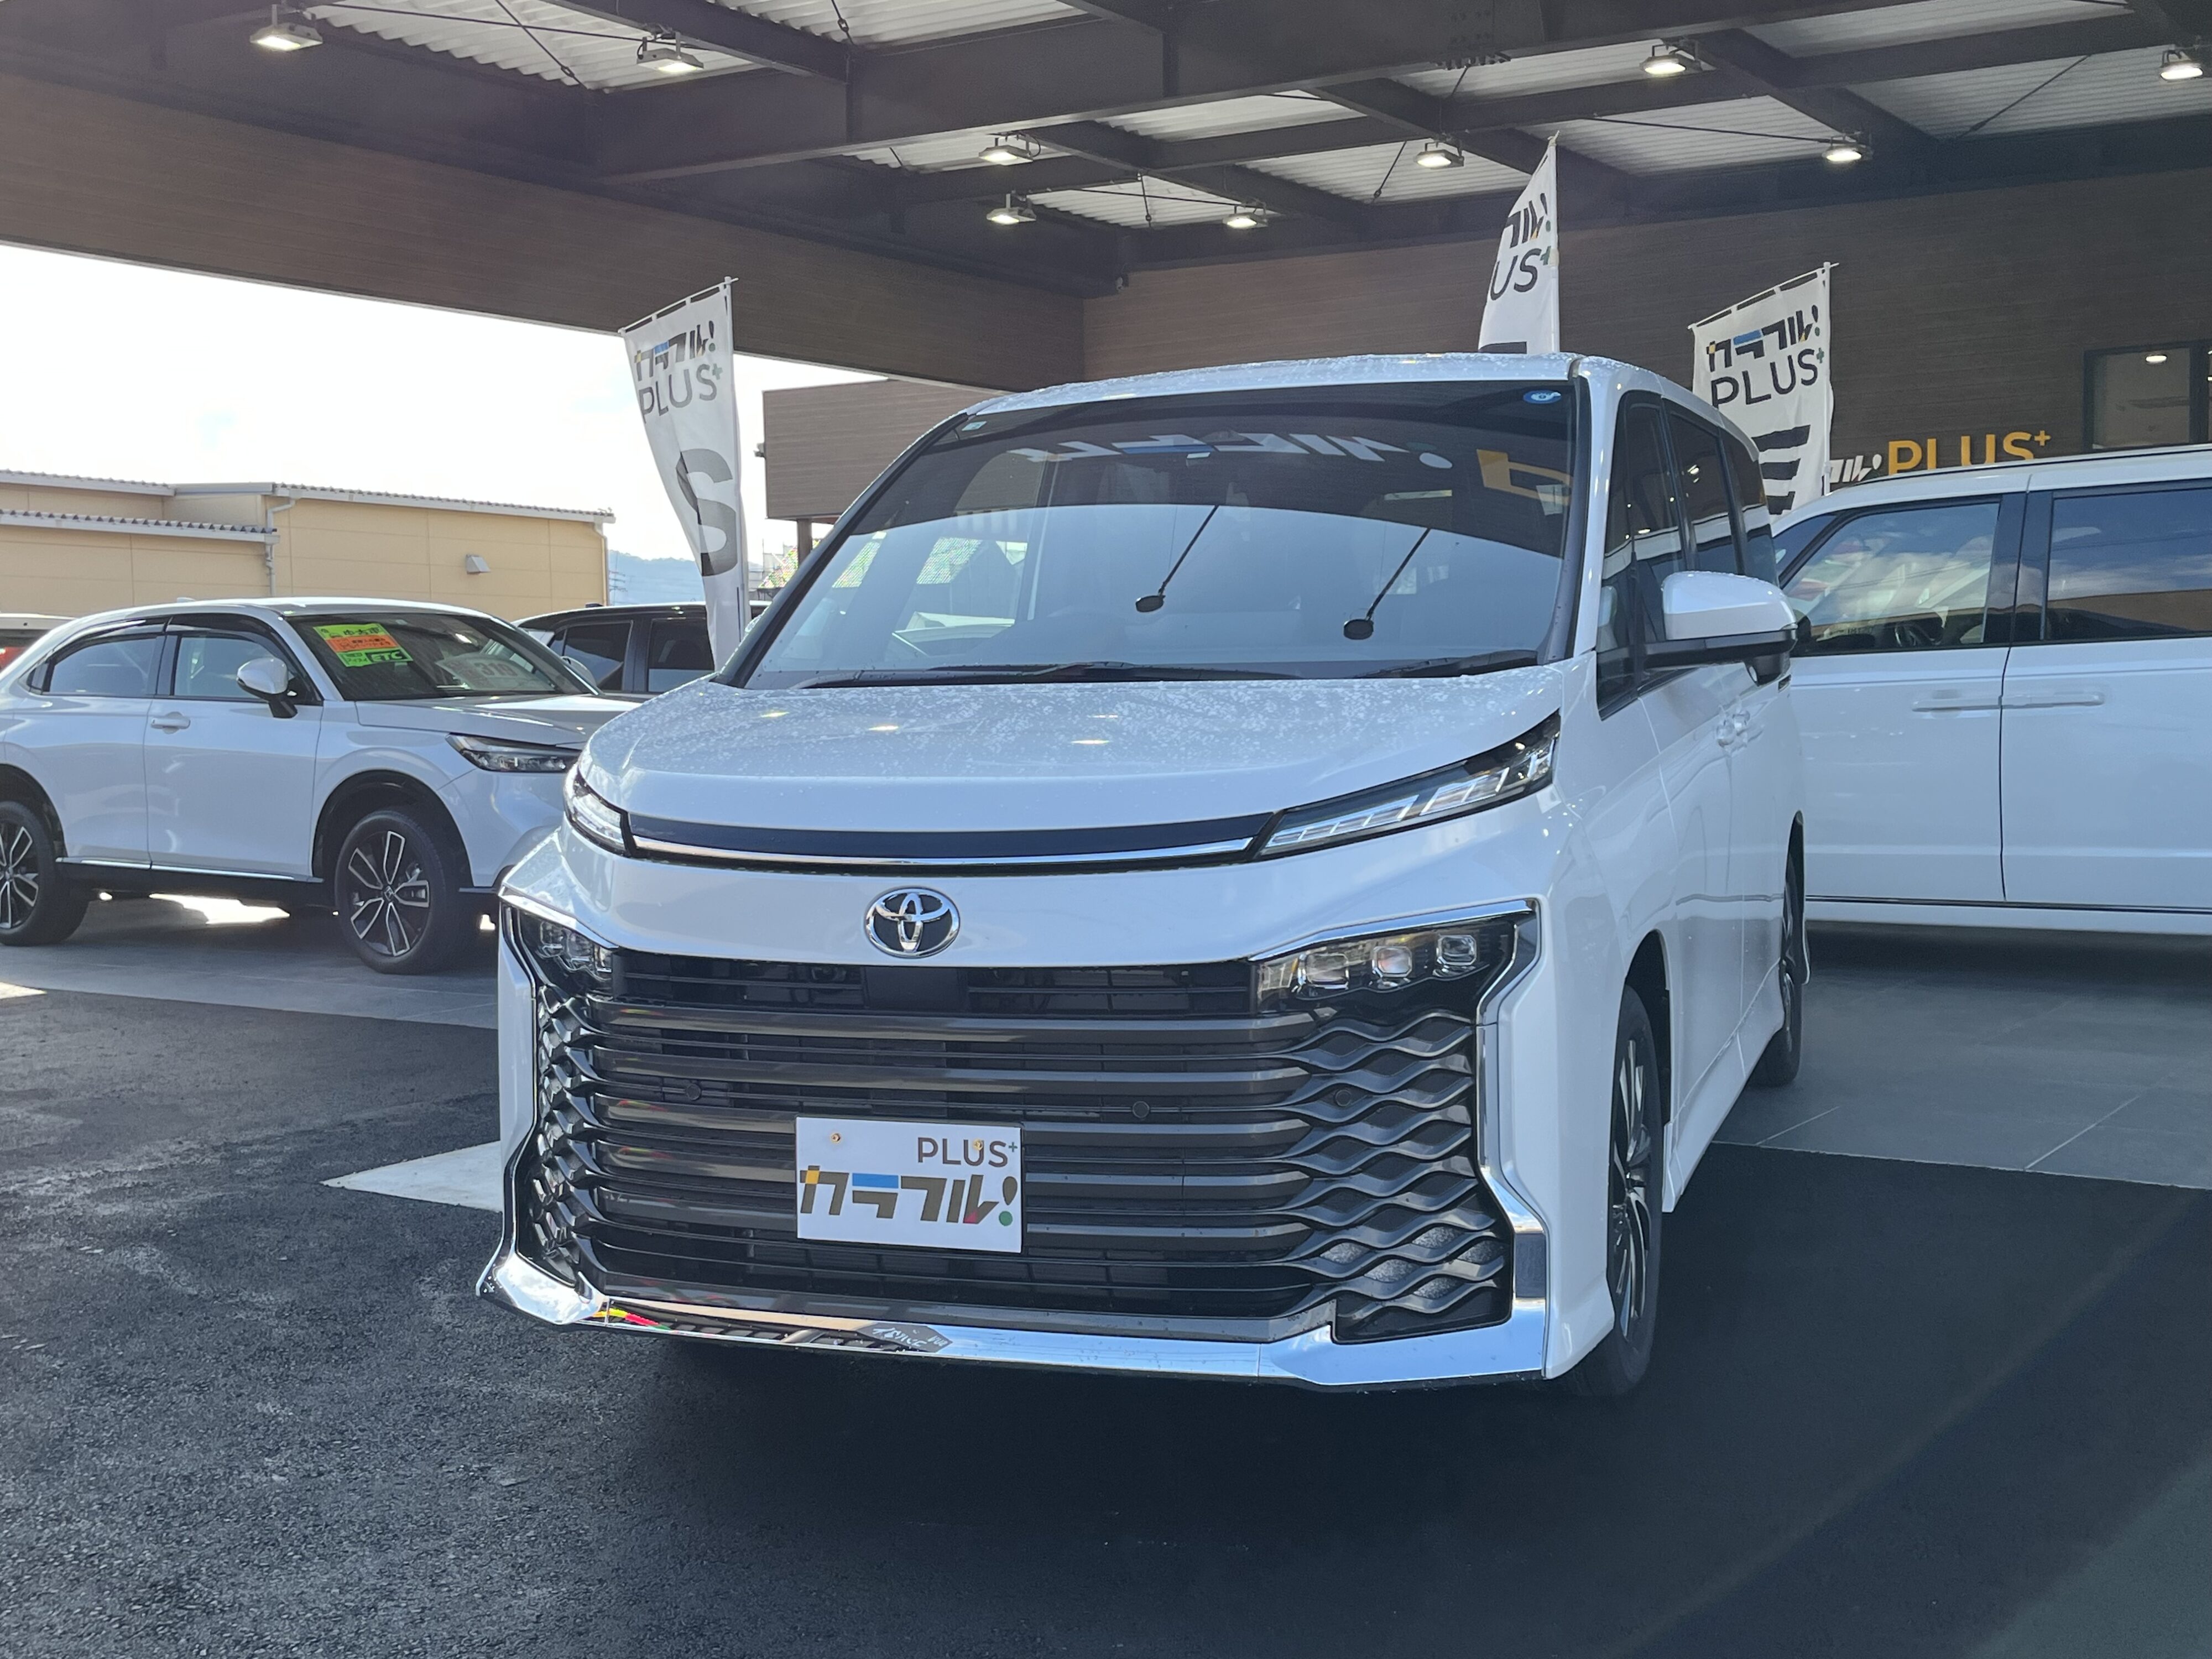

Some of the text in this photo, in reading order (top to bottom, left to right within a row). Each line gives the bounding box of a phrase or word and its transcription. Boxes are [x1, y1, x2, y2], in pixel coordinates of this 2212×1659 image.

[1706, 305, 1820, 372] カラフル!
[371, 651, 403, 661] ETC
[800, 1165, 1018, 1227] カラフル!
